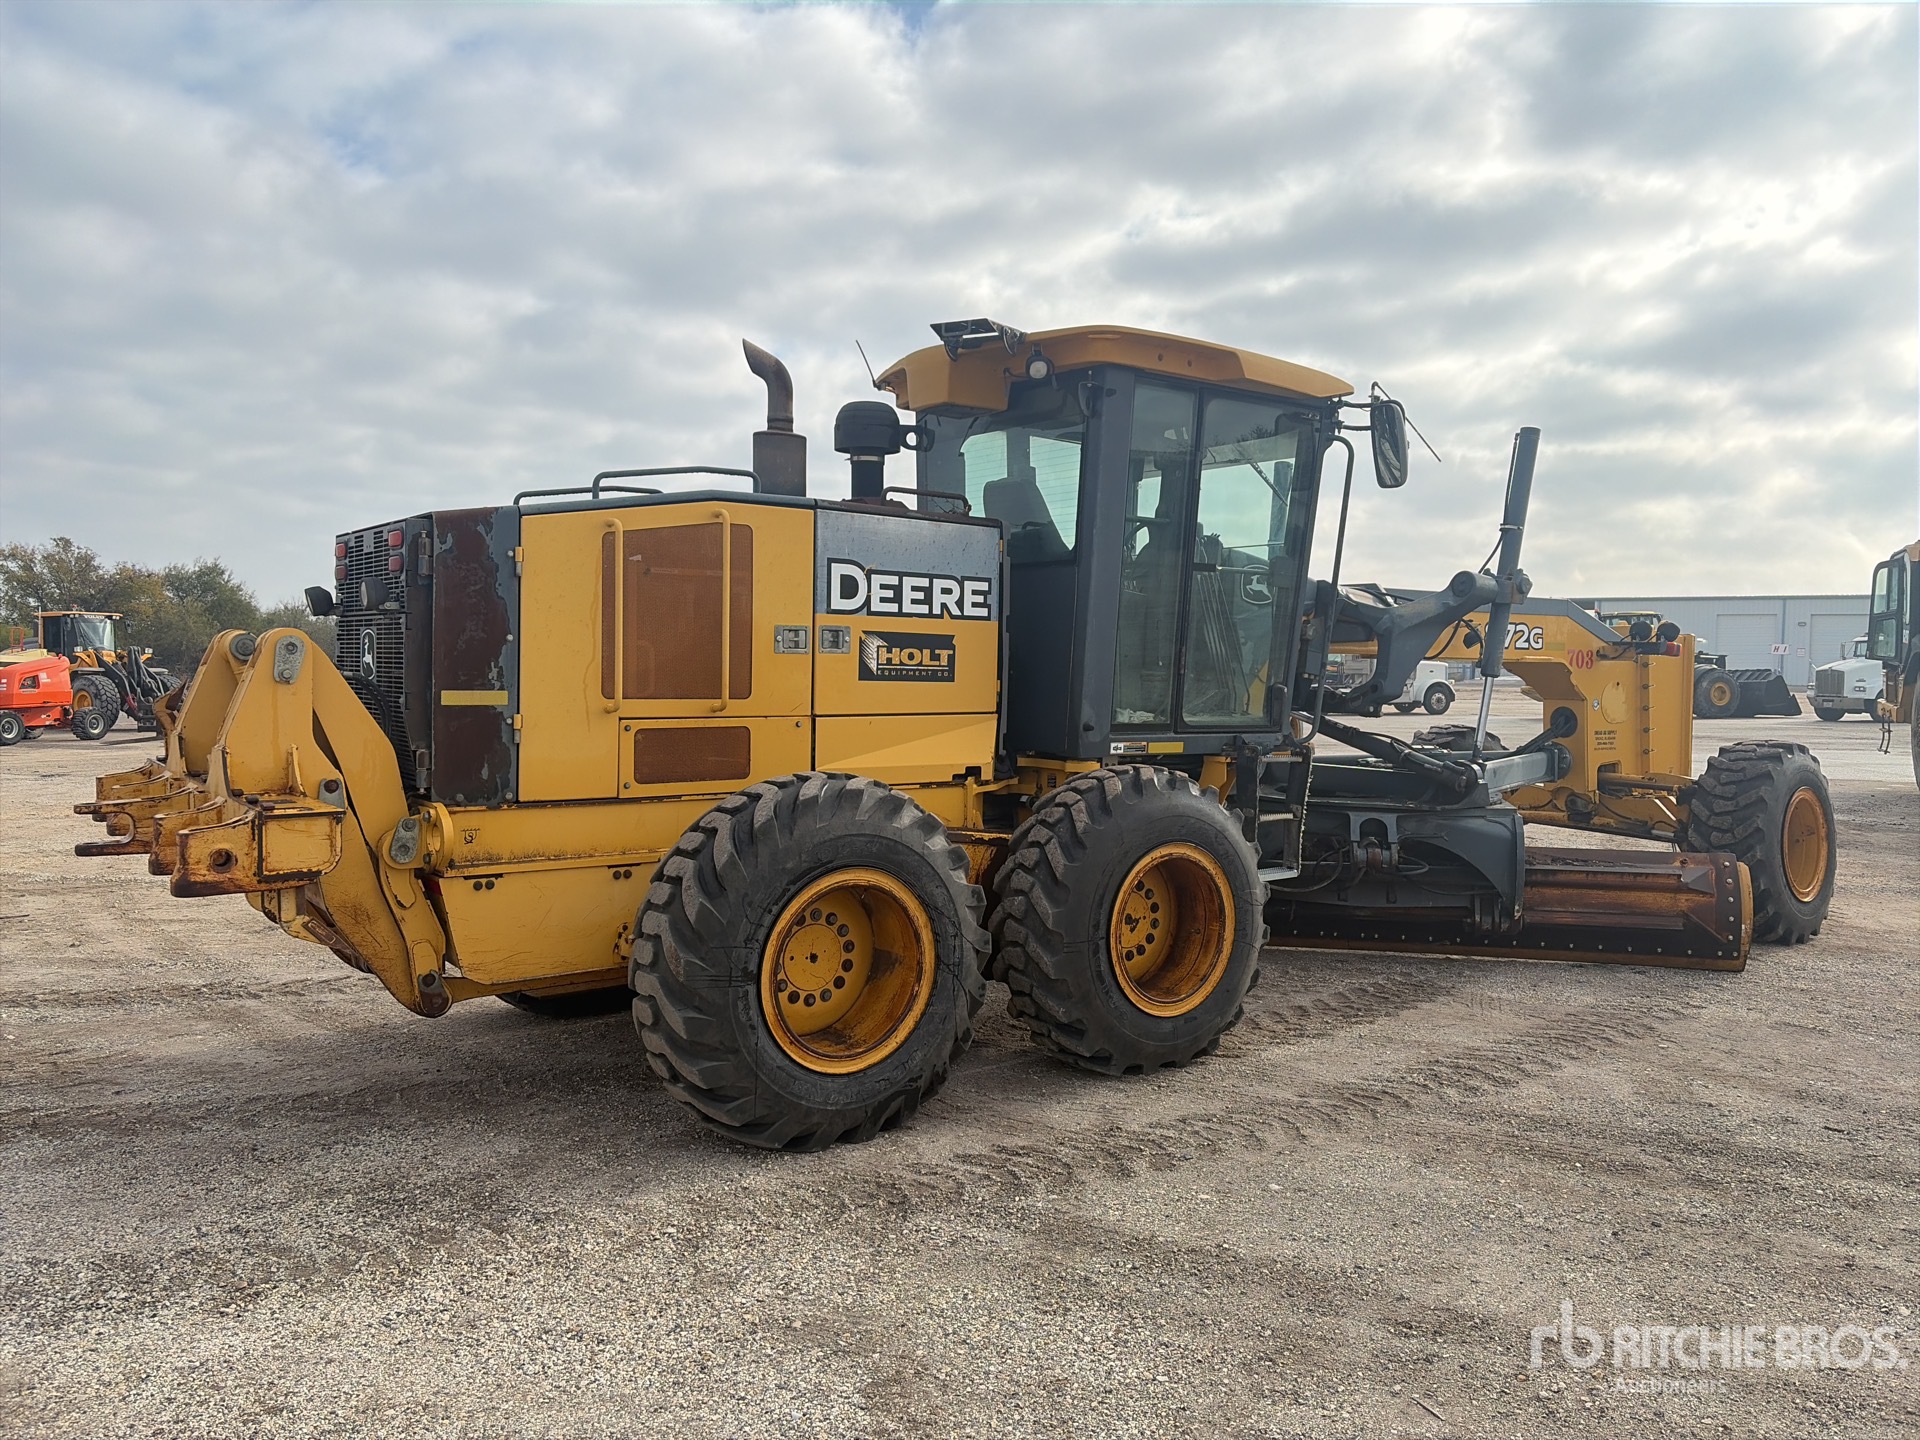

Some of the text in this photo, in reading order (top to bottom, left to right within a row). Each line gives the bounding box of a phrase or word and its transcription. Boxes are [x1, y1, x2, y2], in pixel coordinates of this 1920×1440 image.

[829, 560, 990, 618] DEERE
[1485, 622, 1544, 650] 72G
[878, 647, 953, 666] HOLT
[1567, 648, 1594, 670] 703
[877, 669, 932, 677] EQUIPMENT
